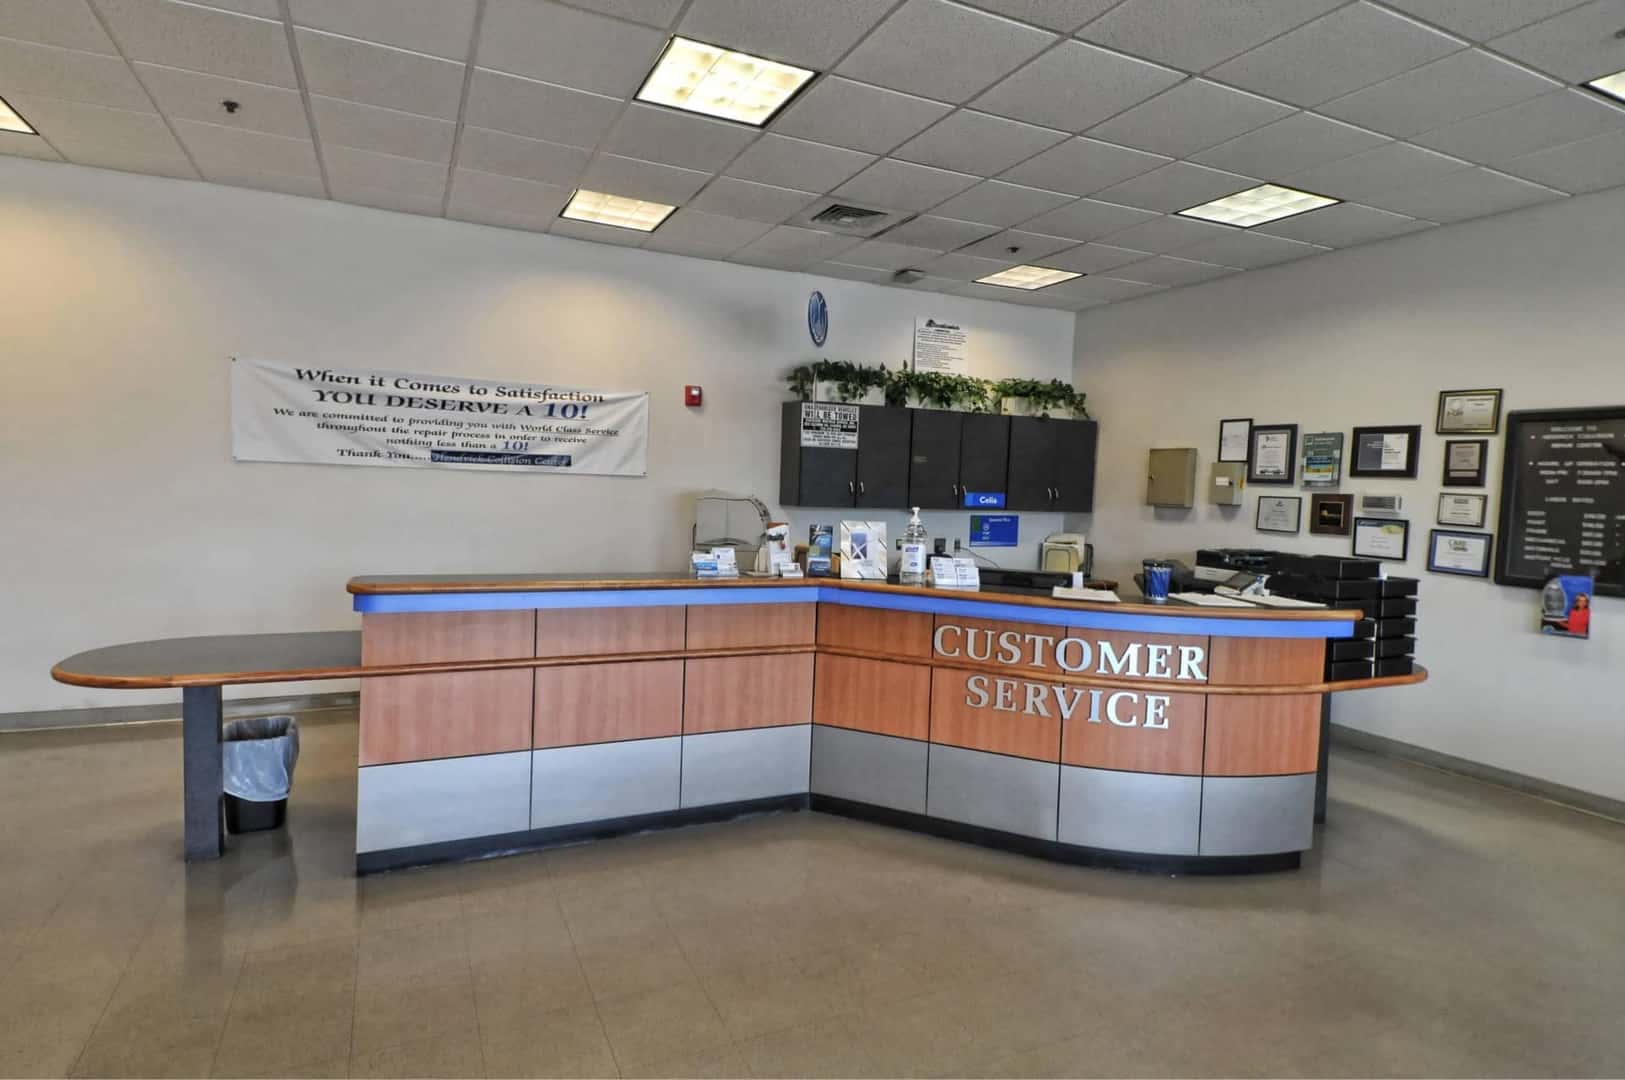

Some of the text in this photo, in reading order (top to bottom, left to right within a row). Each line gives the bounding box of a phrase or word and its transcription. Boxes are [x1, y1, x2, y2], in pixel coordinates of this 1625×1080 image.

[294, 367, 604, 403] When it Comes to Satisfaction
[312, 389, 589, 420] YOU DESERVE A 10!
[273, 407, 295, 417] We
[322, 411, 388, 423] committed
[393, 416, 404, 424] to
[408, 416, 464, 429] providing
[467, 422, 488, 431] you
[491, 421, 516, 431] with
[520, 423, 552, 433] World
[555, 425, 581, 434] Class
[585, 428, 620, 437] Service
[317, 422, 588, 444] throughout the repair process in order to receive
[336, 448, 382, 459] Thank
[386, 437, 432, 448] nothing
[437, 439, 458, 448] less
[460, 440, 487, 450] than
[502, 440, 529, 451] 10!
[934, 624, 1208, 681] CUSTOMER
[966, 675, 1170, 729] SERVICE
